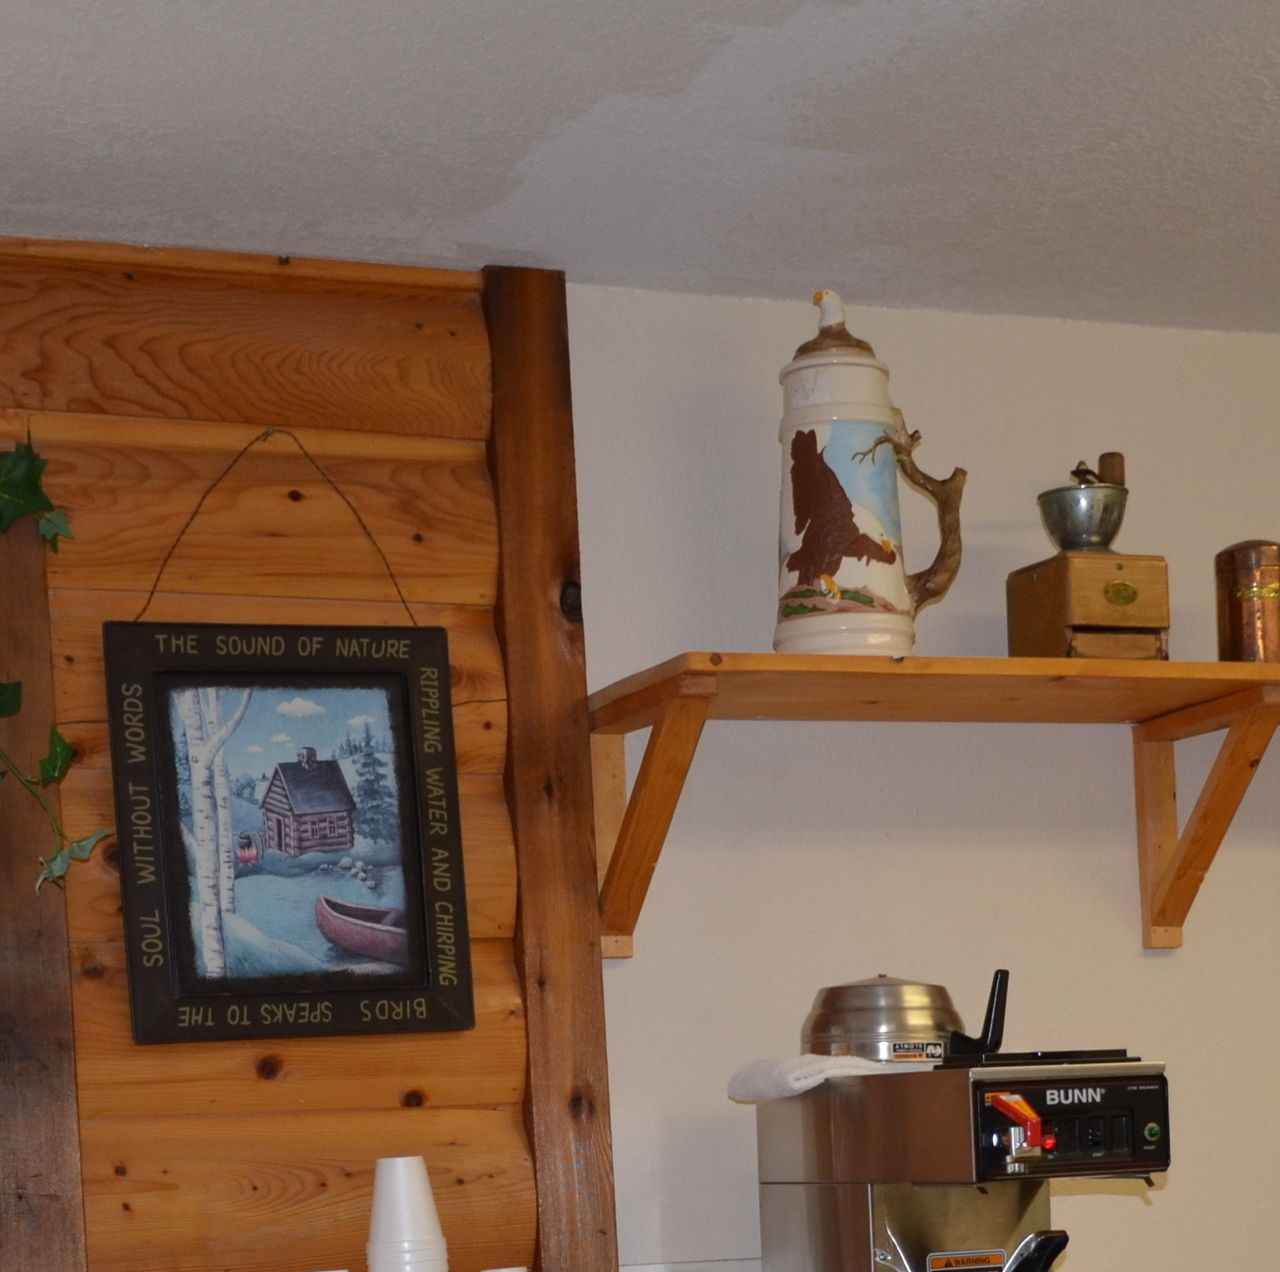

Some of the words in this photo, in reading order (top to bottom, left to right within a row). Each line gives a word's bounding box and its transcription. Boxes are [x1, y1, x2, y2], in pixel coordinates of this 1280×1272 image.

[154, 633, 198, 655] THE
[215, 634, 286, 657] SOUND
[297, 636, 324, 657] OF
[335, 638, 411, 660] NATURE
[121, 682, 147, 763] WORDS
[419, 666, 442, 754] RIPPLING
[425, 767, 448, 836] WATER
[130, 782, 158, 886] WITHOUT
[431, 847, 452, 894] AND
[141, 908, 165, 968] SOUL
[433, 899, 458, 987] CHIRPING
[177, 1006, 216, 1028] THE
[226, 1004, 251, 1025] TO
[260, 1001, 333, 1024] SPEAKS
[360, 997, 428, 1021] BIRDS
[953, 1256, 991, 1269] WARNING
